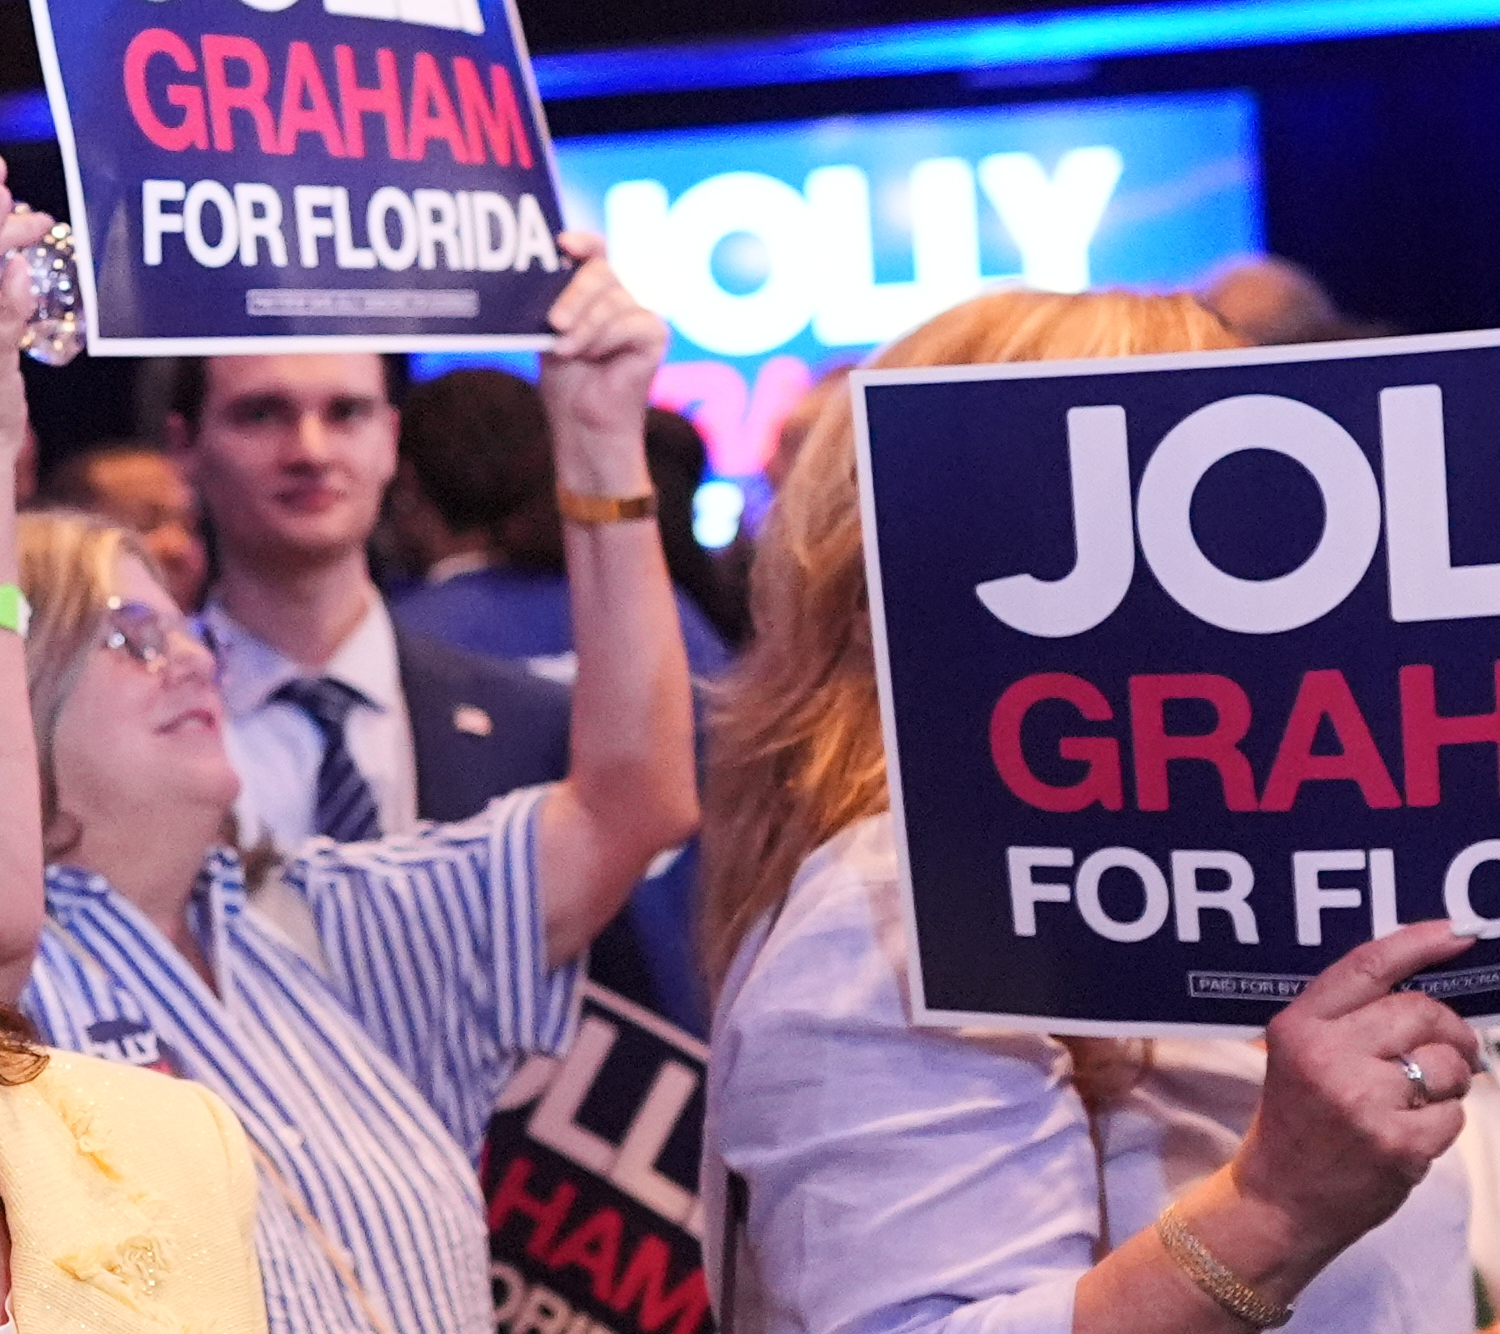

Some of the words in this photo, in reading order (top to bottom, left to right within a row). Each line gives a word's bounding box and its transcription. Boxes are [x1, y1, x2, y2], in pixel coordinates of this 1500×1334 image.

[123, 27, 532, 170] GRAHAM
[142, 178, 287, 269] FOR
[310, 187, 558, 272] FLORIDA
[1007, 845, 1259, 944] FOR
